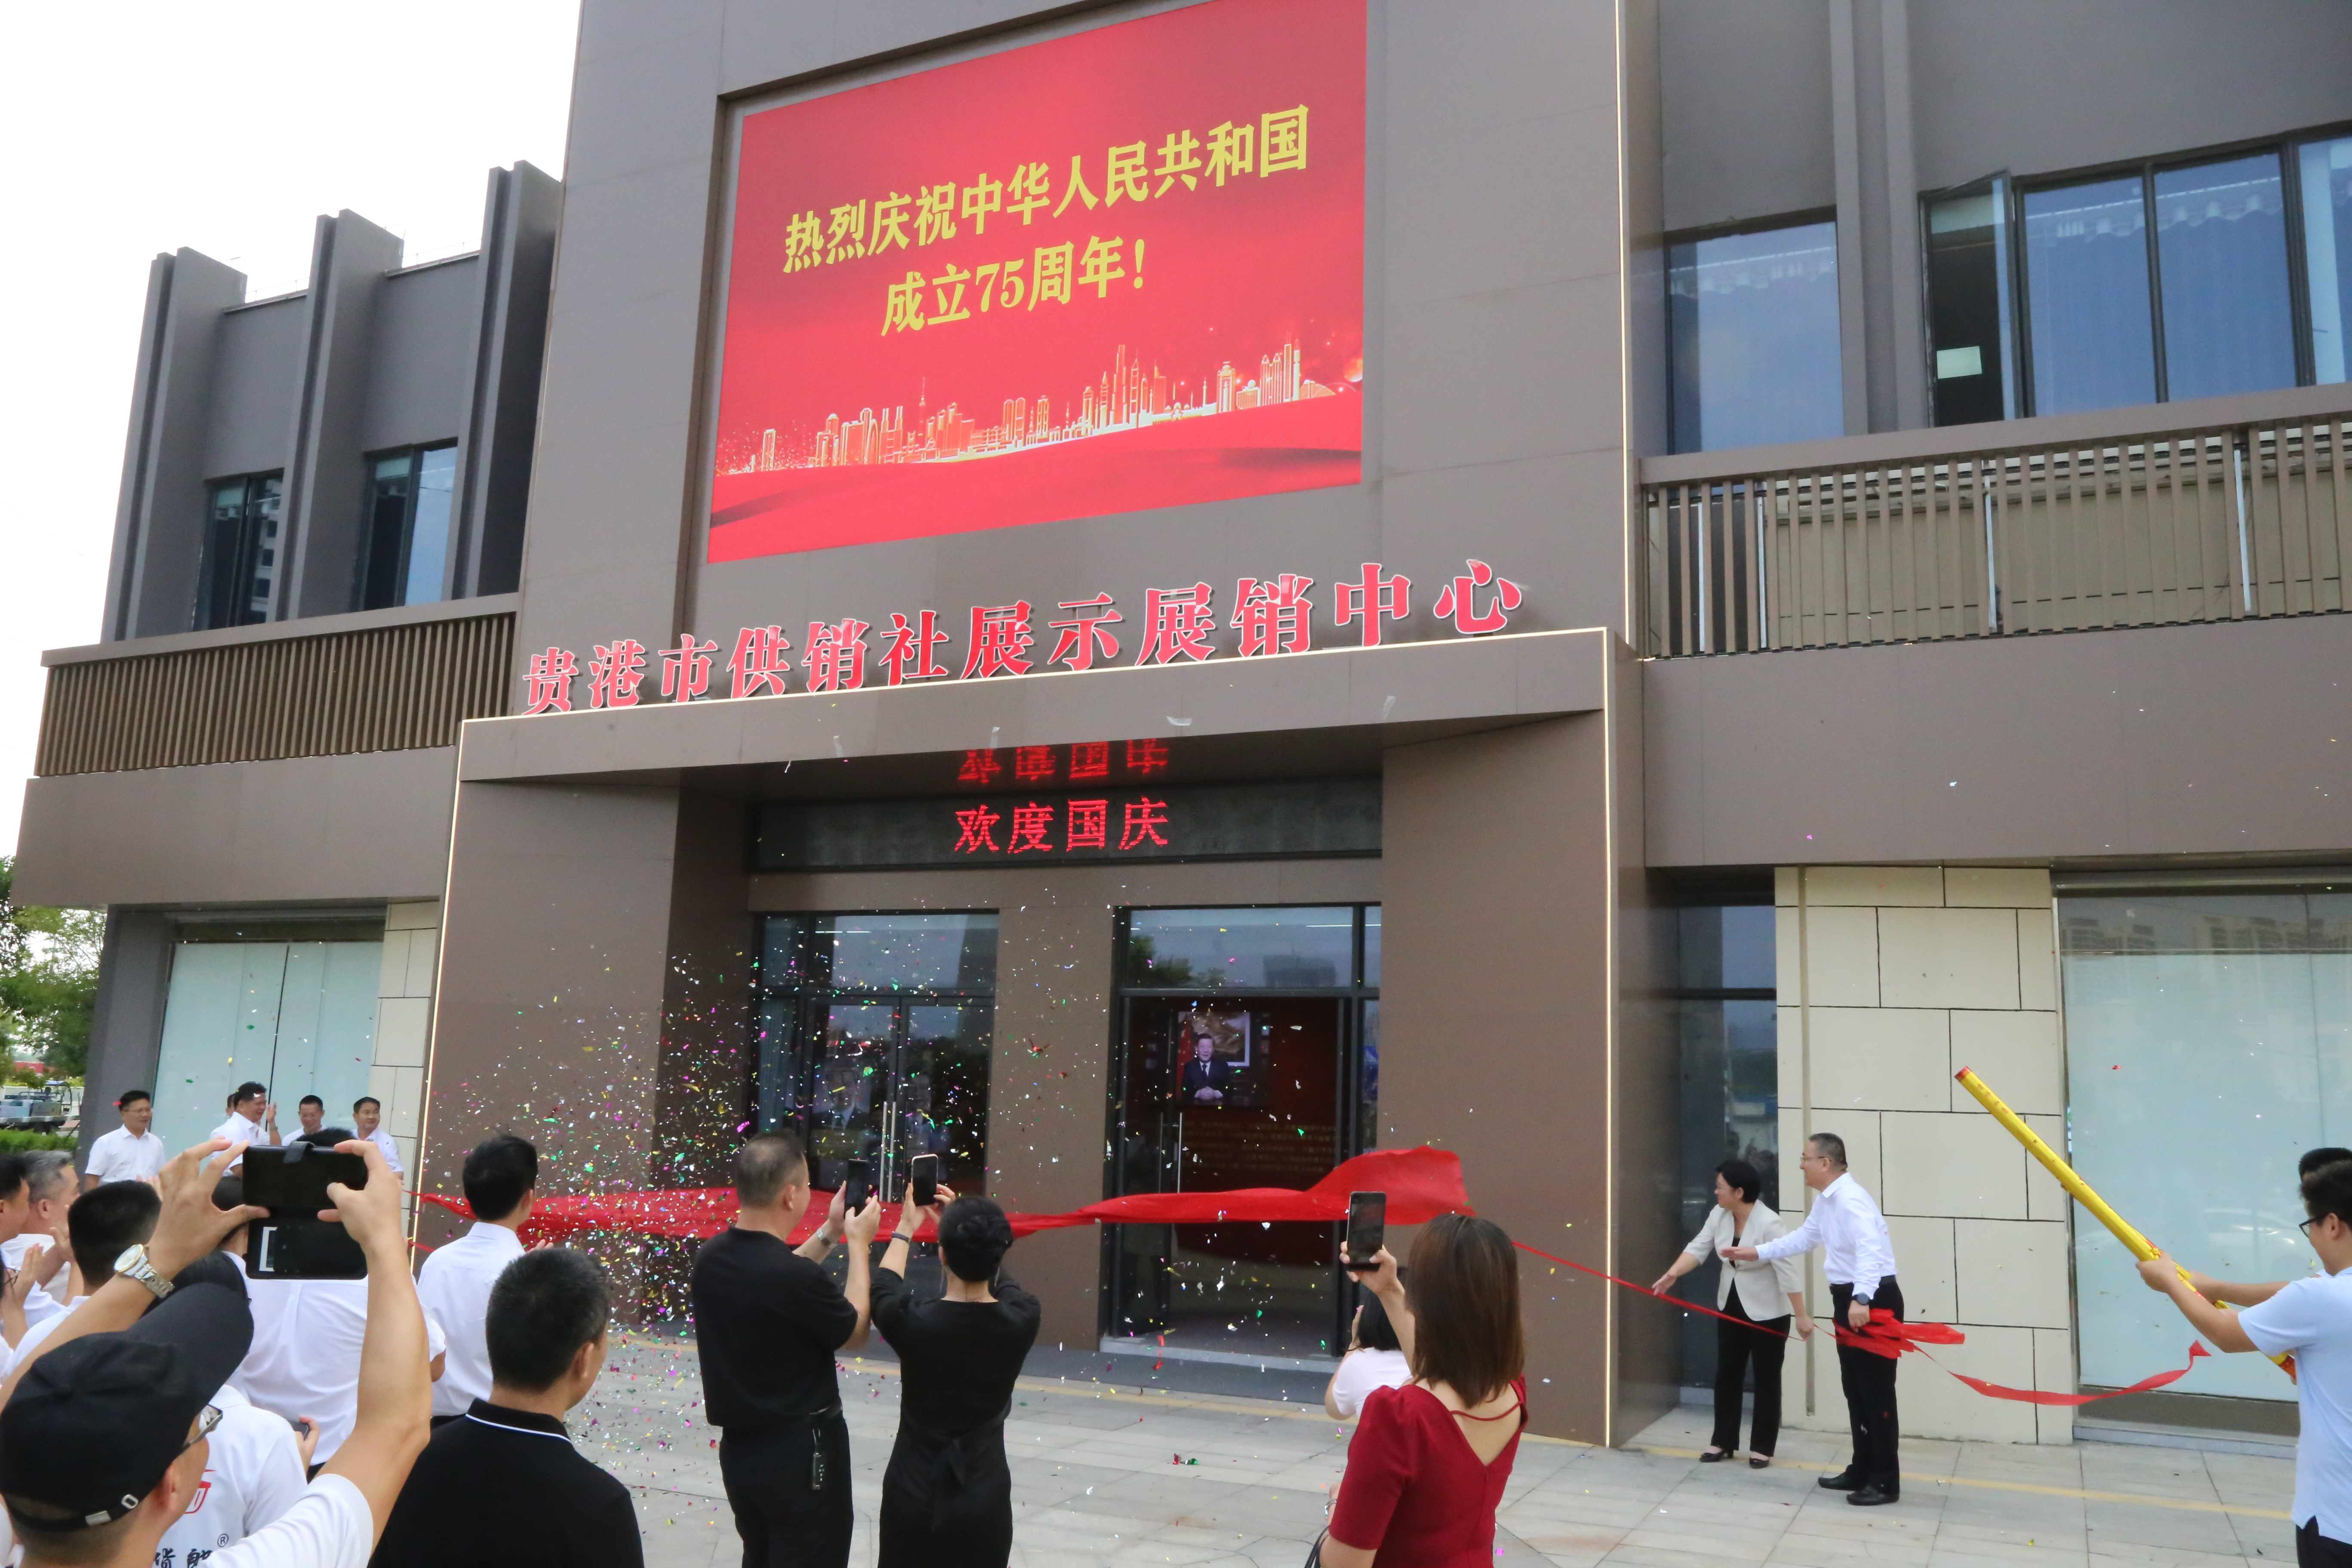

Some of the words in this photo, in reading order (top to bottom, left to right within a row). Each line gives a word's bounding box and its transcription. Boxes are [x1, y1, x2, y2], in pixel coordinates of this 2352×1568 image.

[783, 104, 1309, 273] 热烈庆祝中华人民共和国
[522, 558, 1523, 716] 贵港市供销社展示展销中心
[954, 796, 1169, 854] 欢度国庆
